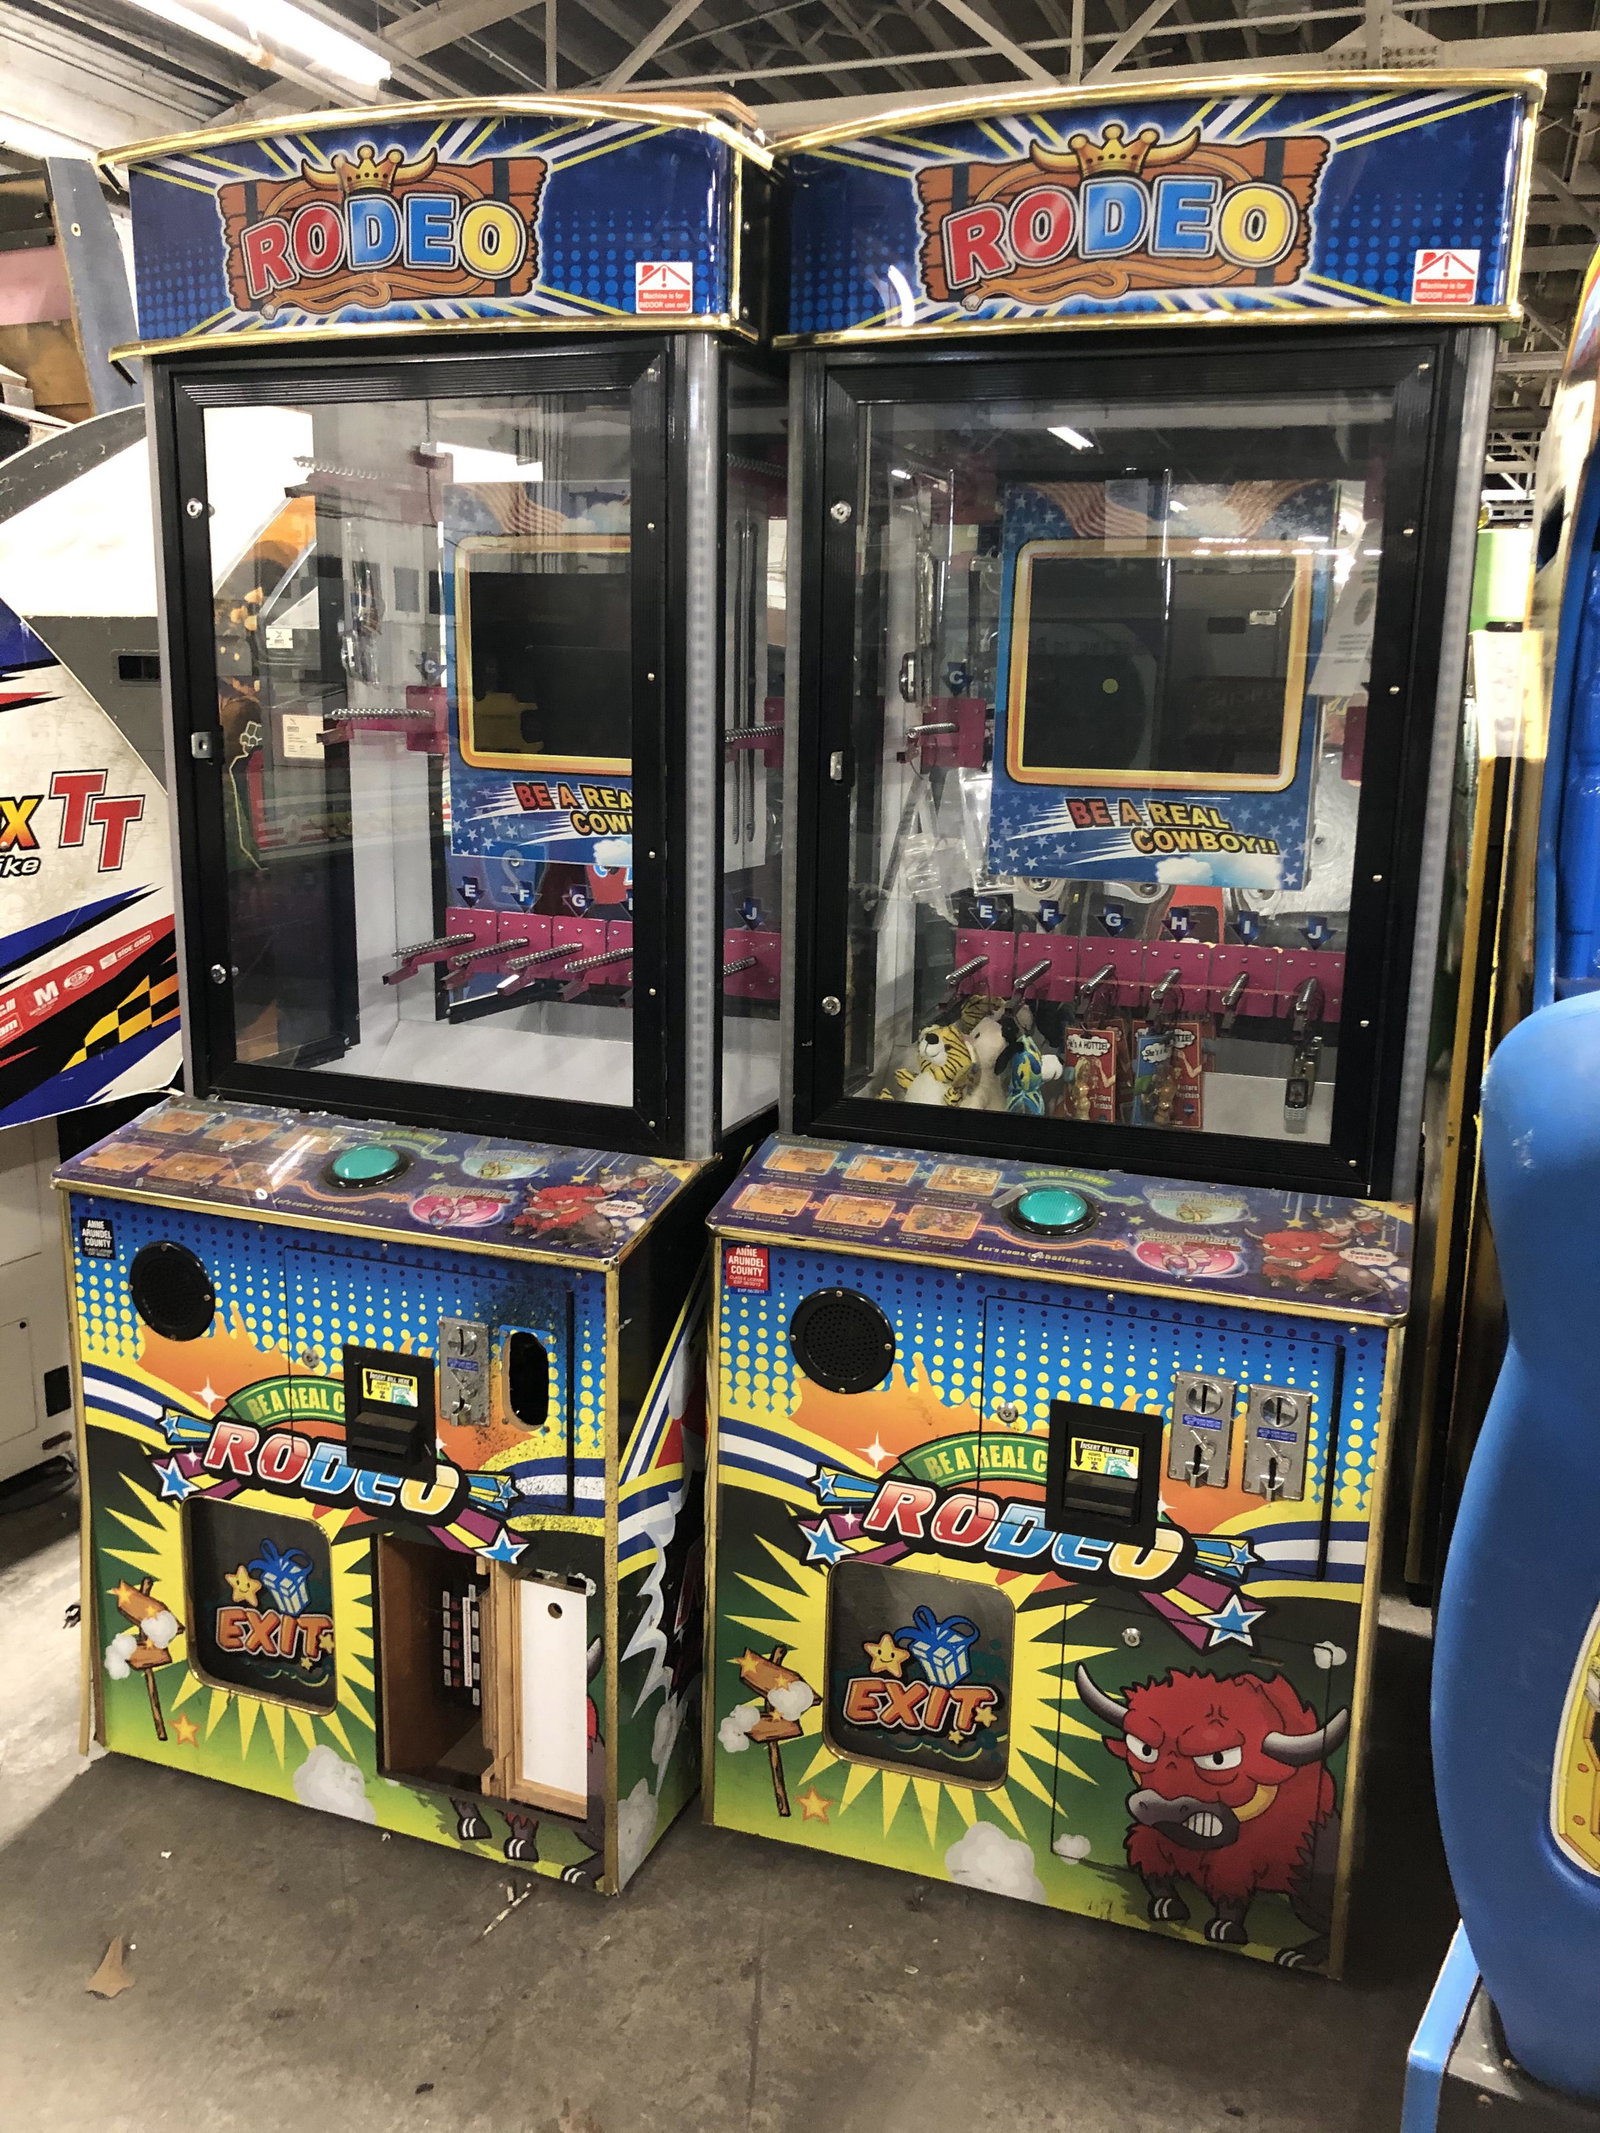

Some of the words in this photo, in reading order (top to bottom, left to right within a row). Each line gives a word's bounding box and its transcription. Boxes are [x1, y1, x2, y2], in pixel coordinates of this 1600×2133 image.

[942, 176, 1300, 288] RODEO
[241, 193, 527, 297] RODEO
[949, 670, 964, 685] C
[512, 781, 556, 811] BE
[556, 781, 583, 811] A
[1065, 798, 1115, 829] BE
[1118, 798, 1144, 827] A
[1144, 799, 1233, 831] REAL
[569, 810, 632, 836] COW
[1130, 827, 1280, 855] COWBOY!!
[464, 884, 477, 898] E
[518, 889, 530, 902] F
[571, 894, 585, 907] G
[745, 907, 757, 920] J
[979, 904, 993, 918] E
[1042, 908, 1054, 922] F
[1105, 912, 1122, 927] G
[1171, 916, 1187, 931] H
[1243, 920, 1251, 935] I
[1307, 925, 1321, 939] J
[33, 980, 60, 1007] M
[87, 1219, 105, 1229] ANNE
[82, 1228, 112, 1240] ARUNDEL
[84, 1237, 111, 1248] COUNTY
[735, 1247, 758, 1257] ANNE
[728, 1255, 766, 1268] ARUNDEL
[730, 1265, 763, 1277] COUNTY
[270, 1389, 285, 1412] A
[283, 1387, 330, 1411] REAL
[1080, 1441, 1101, 1451] INSERT
[1101, 1445, 1113, 1453] BILL
[1114, 1448, 1130, 1456] HERE
[923, 1451, 955, 1480] BE
[954, 1447, 971, 1470] A
[971, 1444, 1028, 1470] REAL
[215, 1606, 334, 1662] EXIT
[843, 1677, 998, 1735] EXIT
